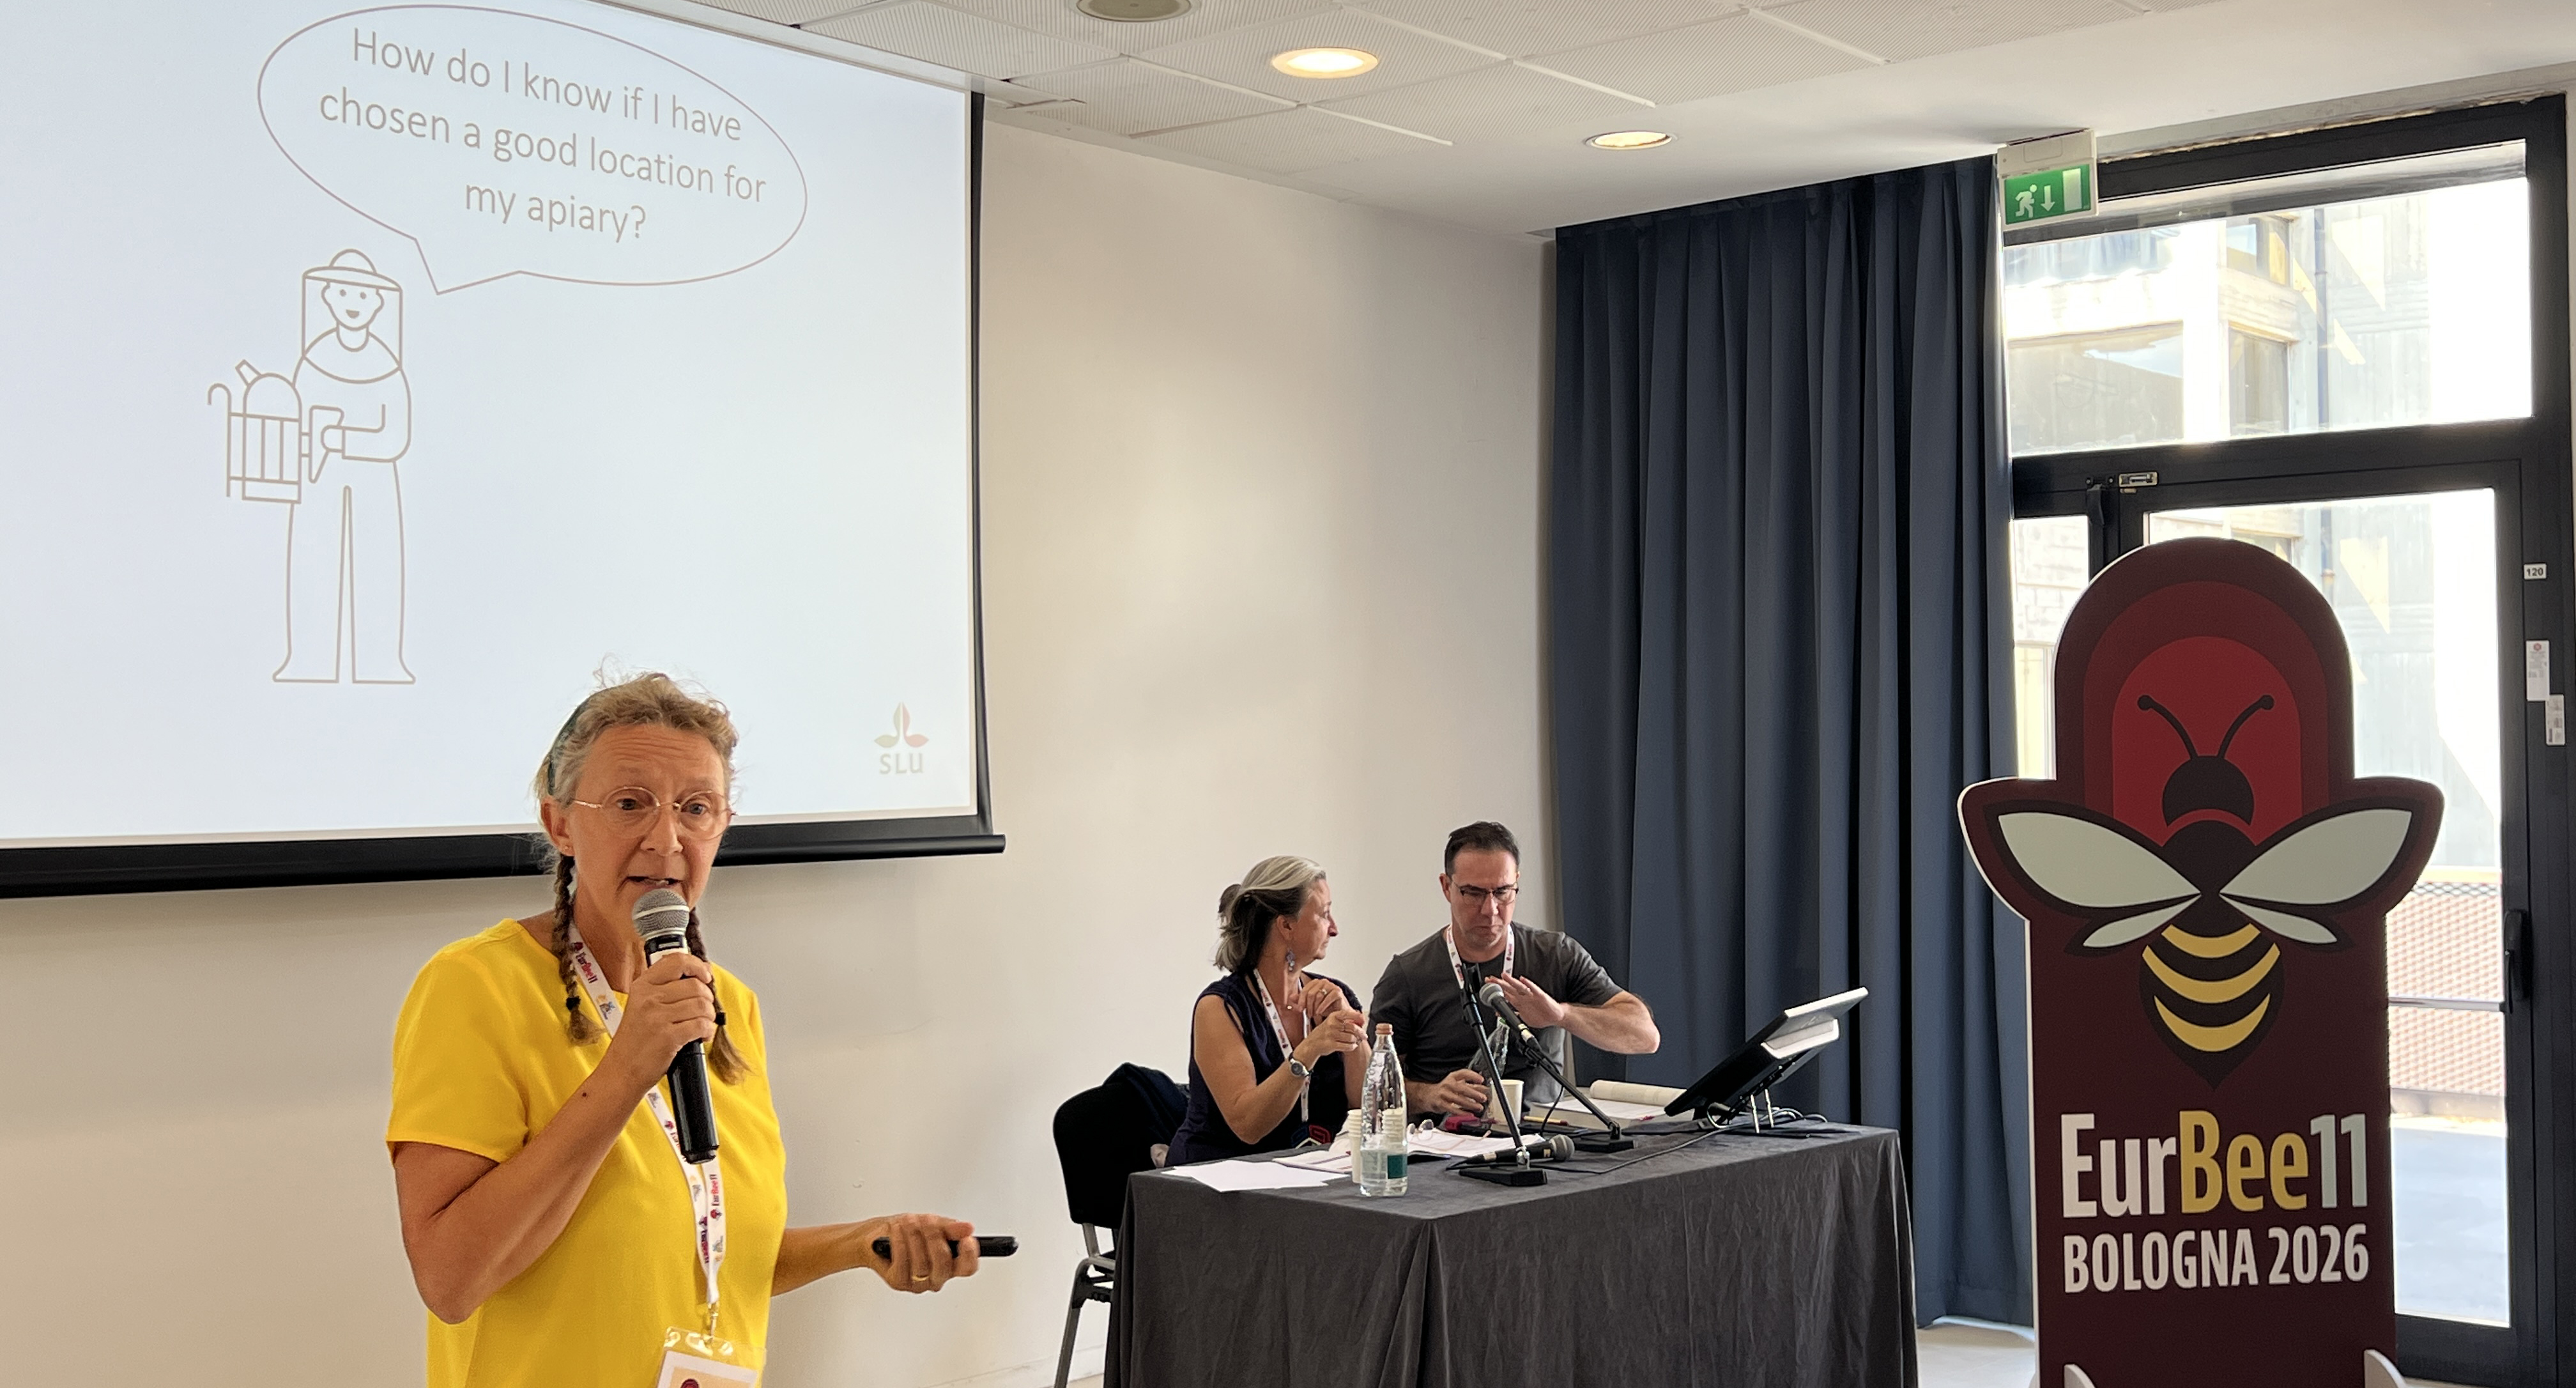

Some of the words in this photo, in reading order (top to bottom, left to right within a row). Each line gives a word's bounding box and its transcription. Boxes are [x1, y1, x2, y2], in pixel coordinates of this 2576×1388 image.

[354, 27, 435, 76] How
[447, 47, 491, 88] do
[503, 59, 510, 94] I
[525, 61, 612, 113] know
[624, 86, 644, 120] if
[654, 93, 659, 125] I
[672, 94, 742, 141] have
[320, 86, 450, 144] chosen
[463, 123, 480, 150] a
[493, 128, 577, 167] good
[590, 136, 714, 194] location
[724, 164, 767, 203] for
[465, 183, 516, 224] my
[527, 195, 646, 243] apiary?
[2526, 567, 2544, 576] 120
[879, 753, 924, 775] SLU
[2060, 1110, 2368, 1217] EurBee11
[2064, 1228, 2258, 1293] BOLOGNA
[2267, 1224, 2369, 1285] 2026
